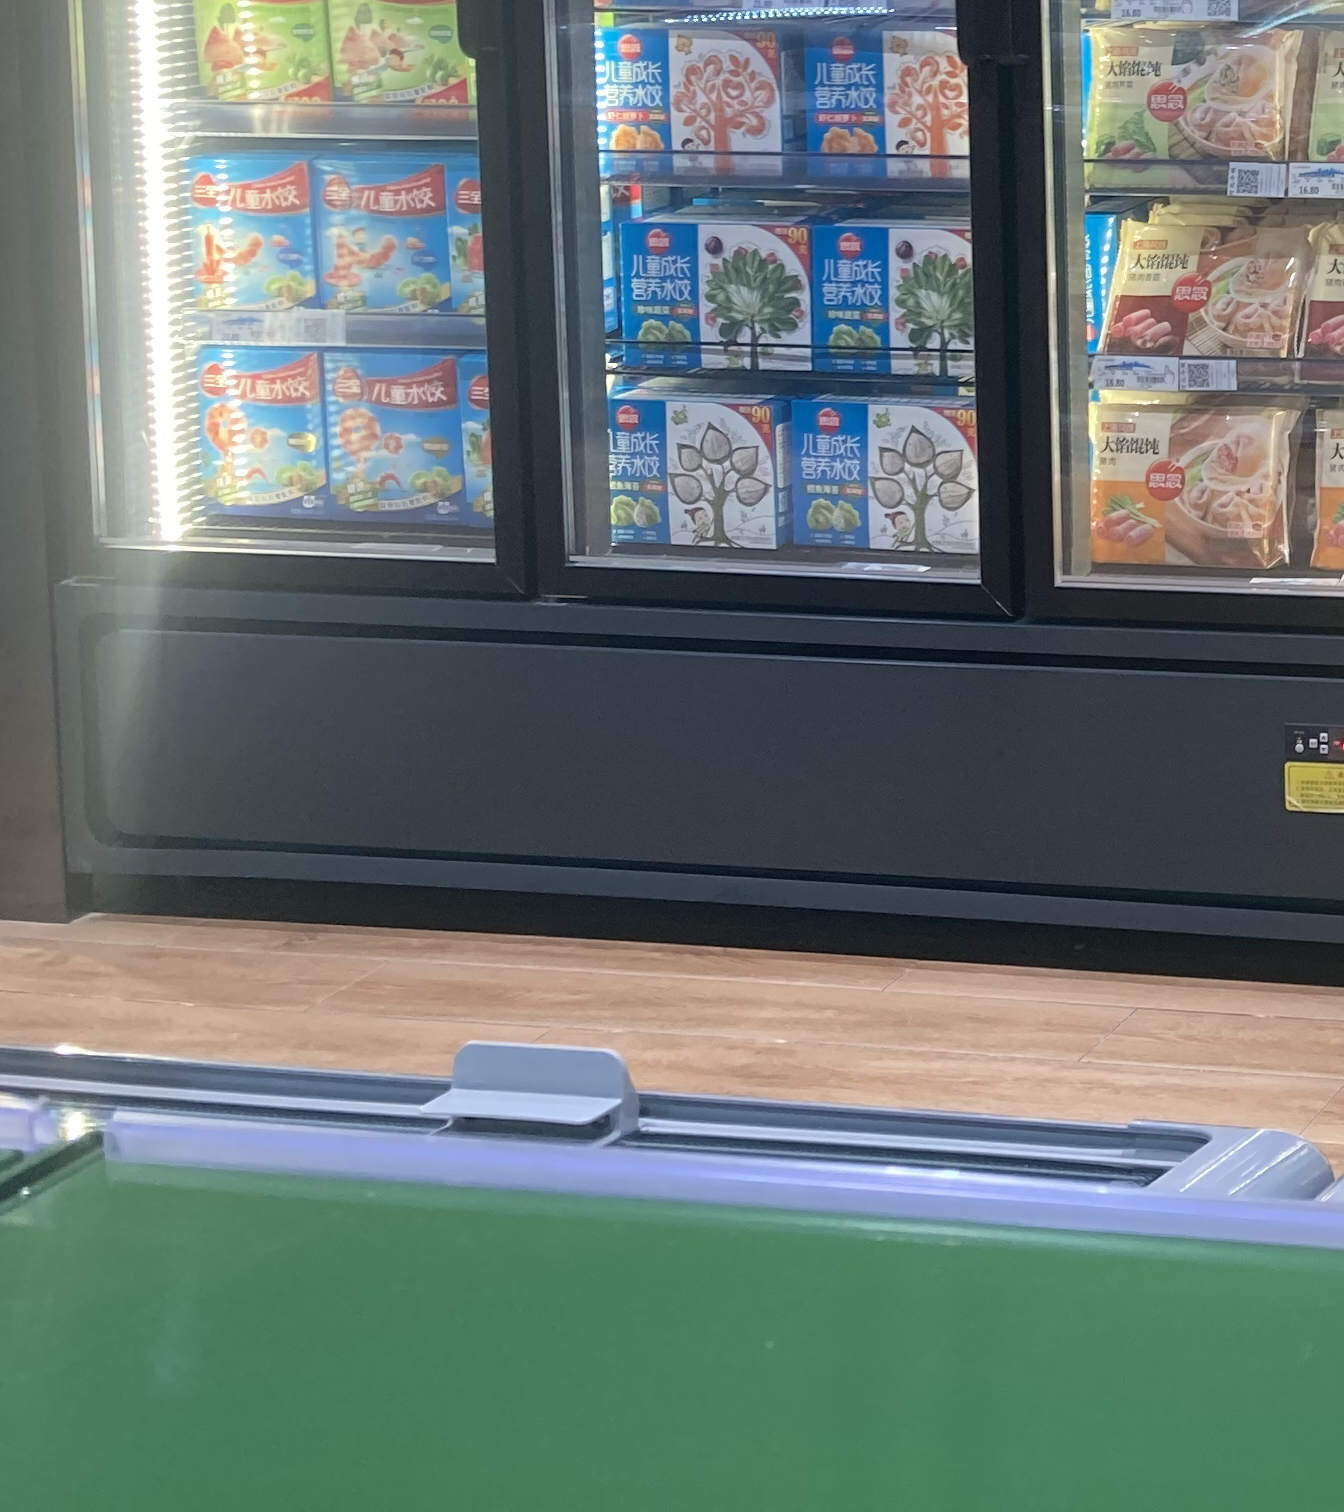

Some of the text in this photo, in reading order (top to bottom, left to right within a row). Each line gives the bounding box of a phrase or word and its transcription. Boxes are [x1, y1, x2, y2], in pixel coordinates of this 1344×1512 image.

[604, 62, 661, 84] 儿童成长
[815, 63, 875, 85] 儿童成长
[1106, 59, 1162, 78] 大馅馄饨
[604, 85, 663, 108] 营养水饺
[816, 86, 876, 110] 营养水饺
[1150, 94, 1185, 110] 思念
[227, 187, 300, 209] 儿童水饺
[361, 187, 436, 210] 儿童水饺
[787, 227, 807, 244] 90
[631, 255, 691, 277] 儿童成长
[822, 260, 882, 282] 儿童成长
[1130, 253, 1189, 271] 大馅馄饨
[631, 278, 691, 302] 营养水饺
[823, 283, 882, 307] 营养水饺
[1173, 286, 1208, 302] 思念
[238, 377, 310, 399] 儿童水饺
[373, 383, 447, 404] 儿童水饺
[751, 406, 770, 423] 90
[801, 435, 860, 457] 儿童成长
[1100, 436, 1160, 456] 大馅馄饨
[802, 458, 860, 480] 营养水饺
[1147, 474, 1182, 490] 思念
